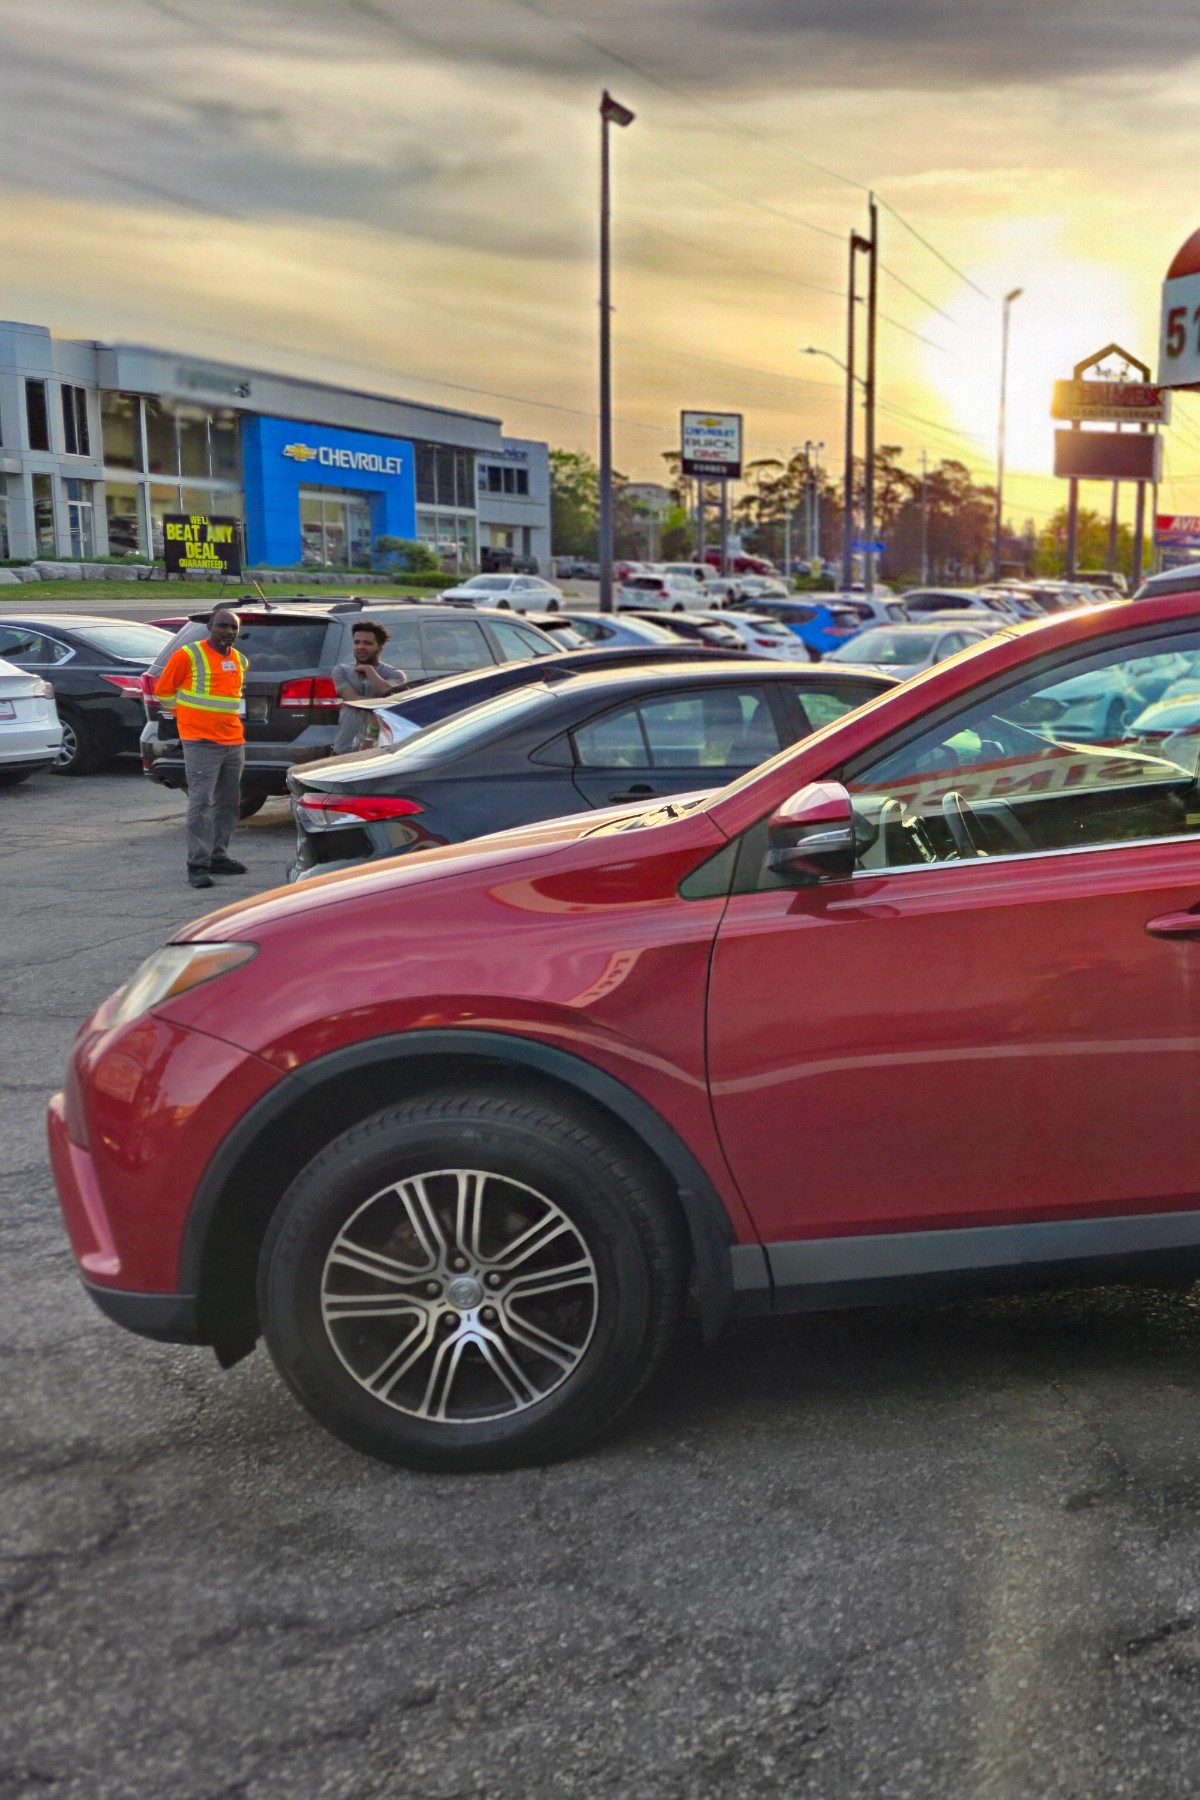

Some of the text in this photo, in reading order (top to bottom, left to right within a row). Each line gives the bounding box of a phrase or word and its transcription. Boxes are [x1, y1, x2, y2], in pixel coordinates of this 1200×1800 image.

[685, 438, 735, 449] BUICK
[318, 446, 403, 475] CHEVROLET
[693, 450, 728, 459] GMC
[166, 523, 233, 543] BEAT ANY
[186, 542, 219, 560] DEAL
